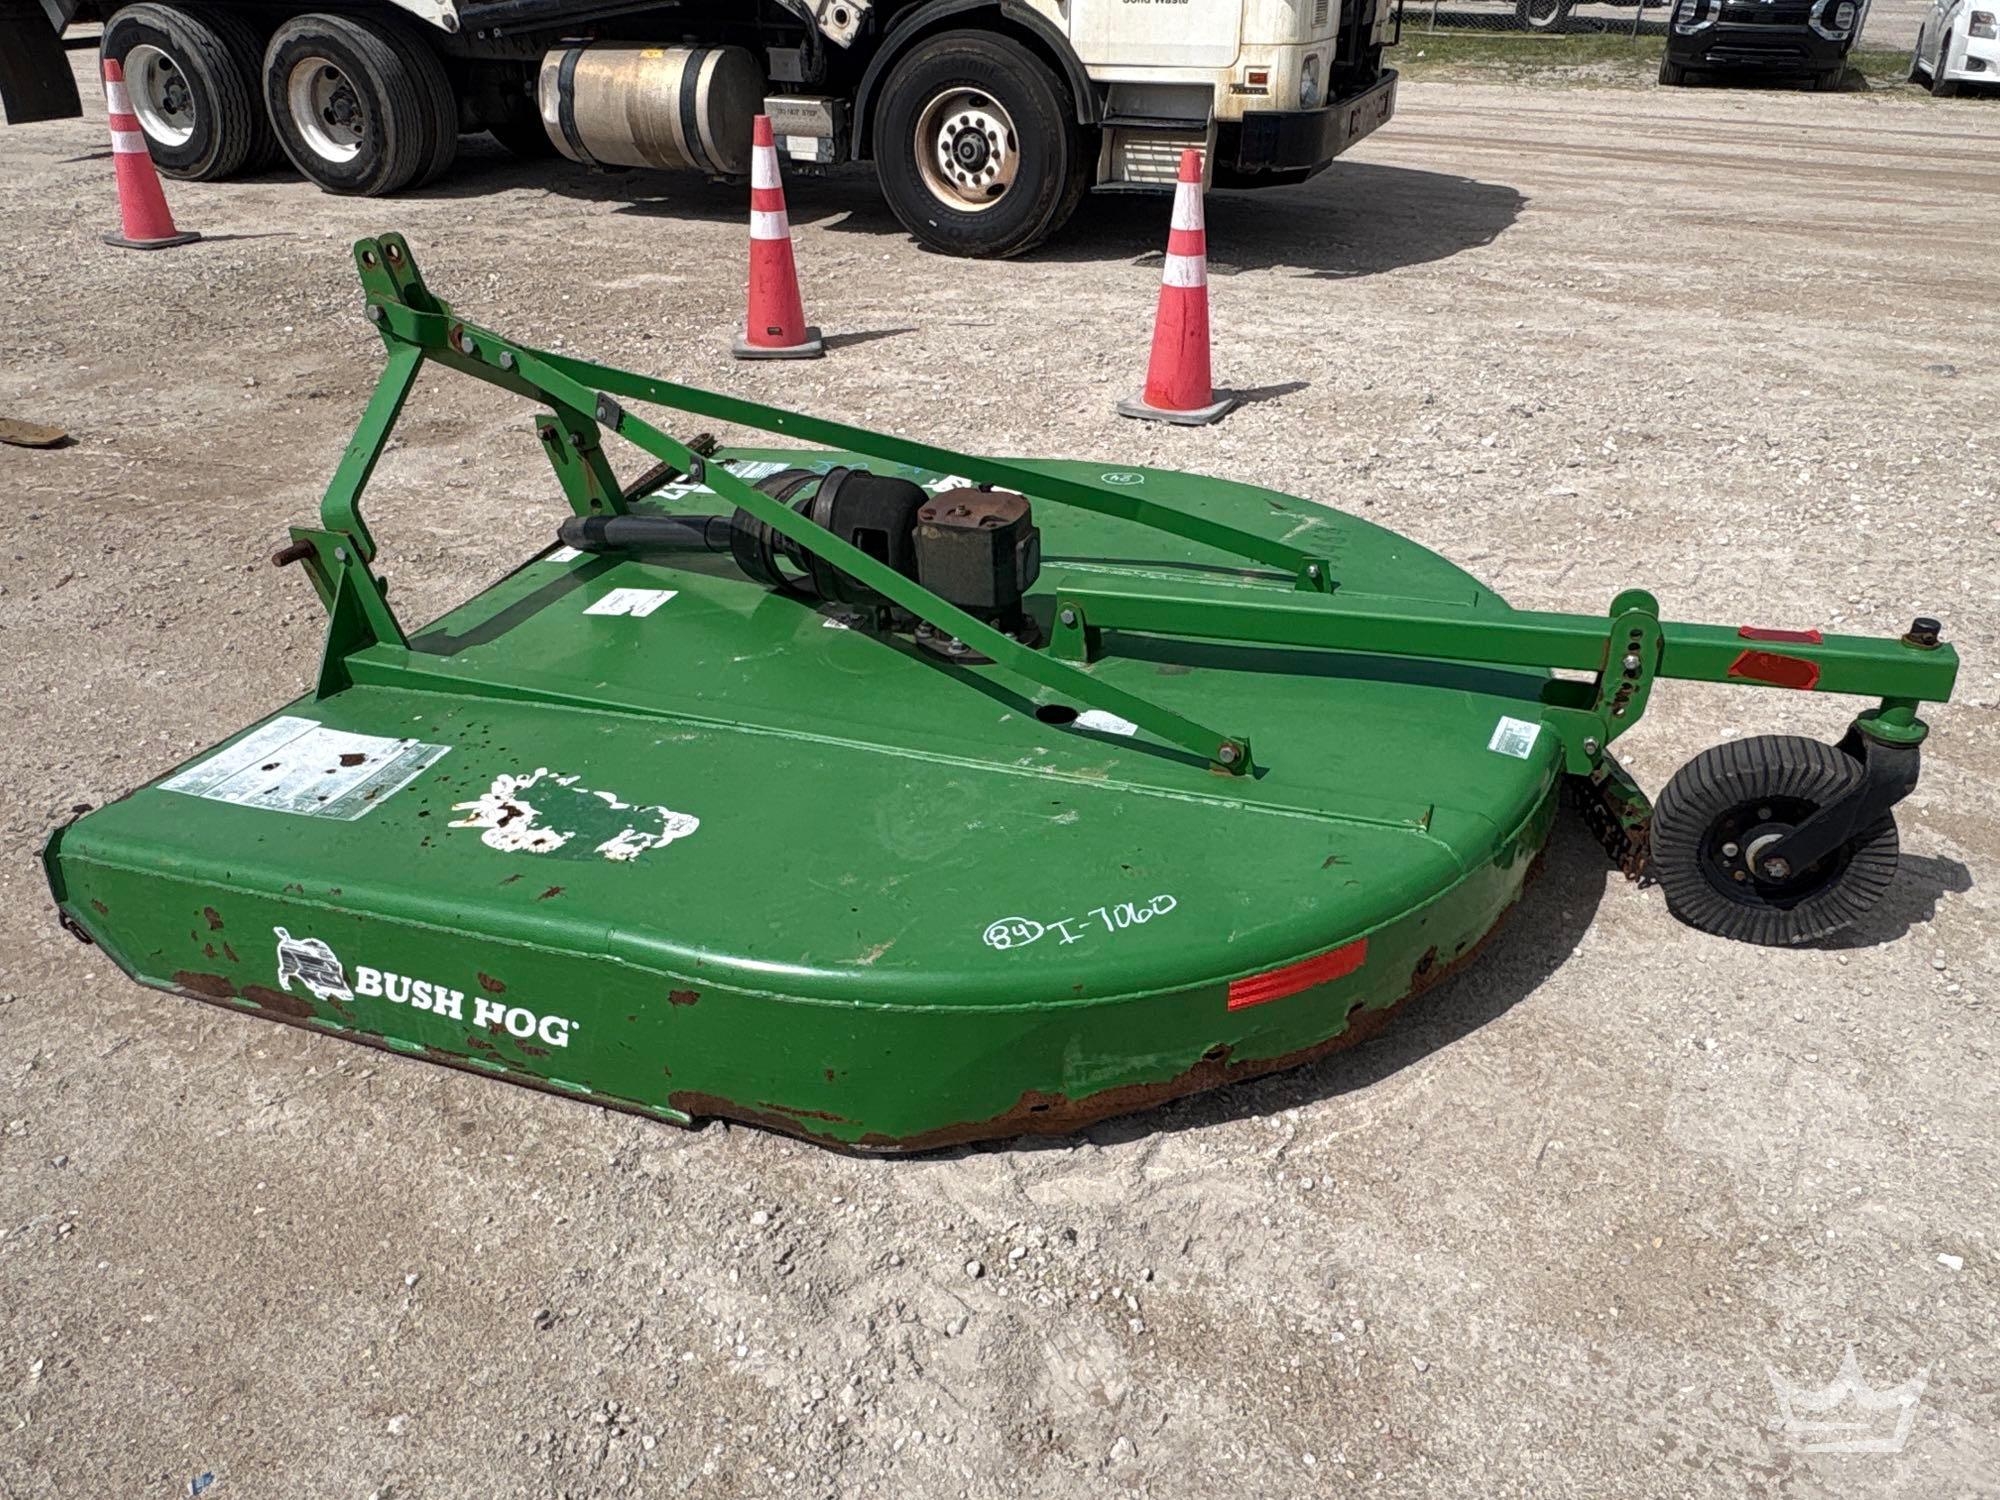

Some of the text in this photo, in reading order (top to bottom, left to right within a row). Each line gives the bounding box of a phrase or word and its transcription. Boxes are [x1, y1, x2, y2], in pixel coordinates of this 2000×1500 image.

[987, 894, 1177, 950] 84 I-7060
[355, 965, 570, 1048] BUSH HOG
